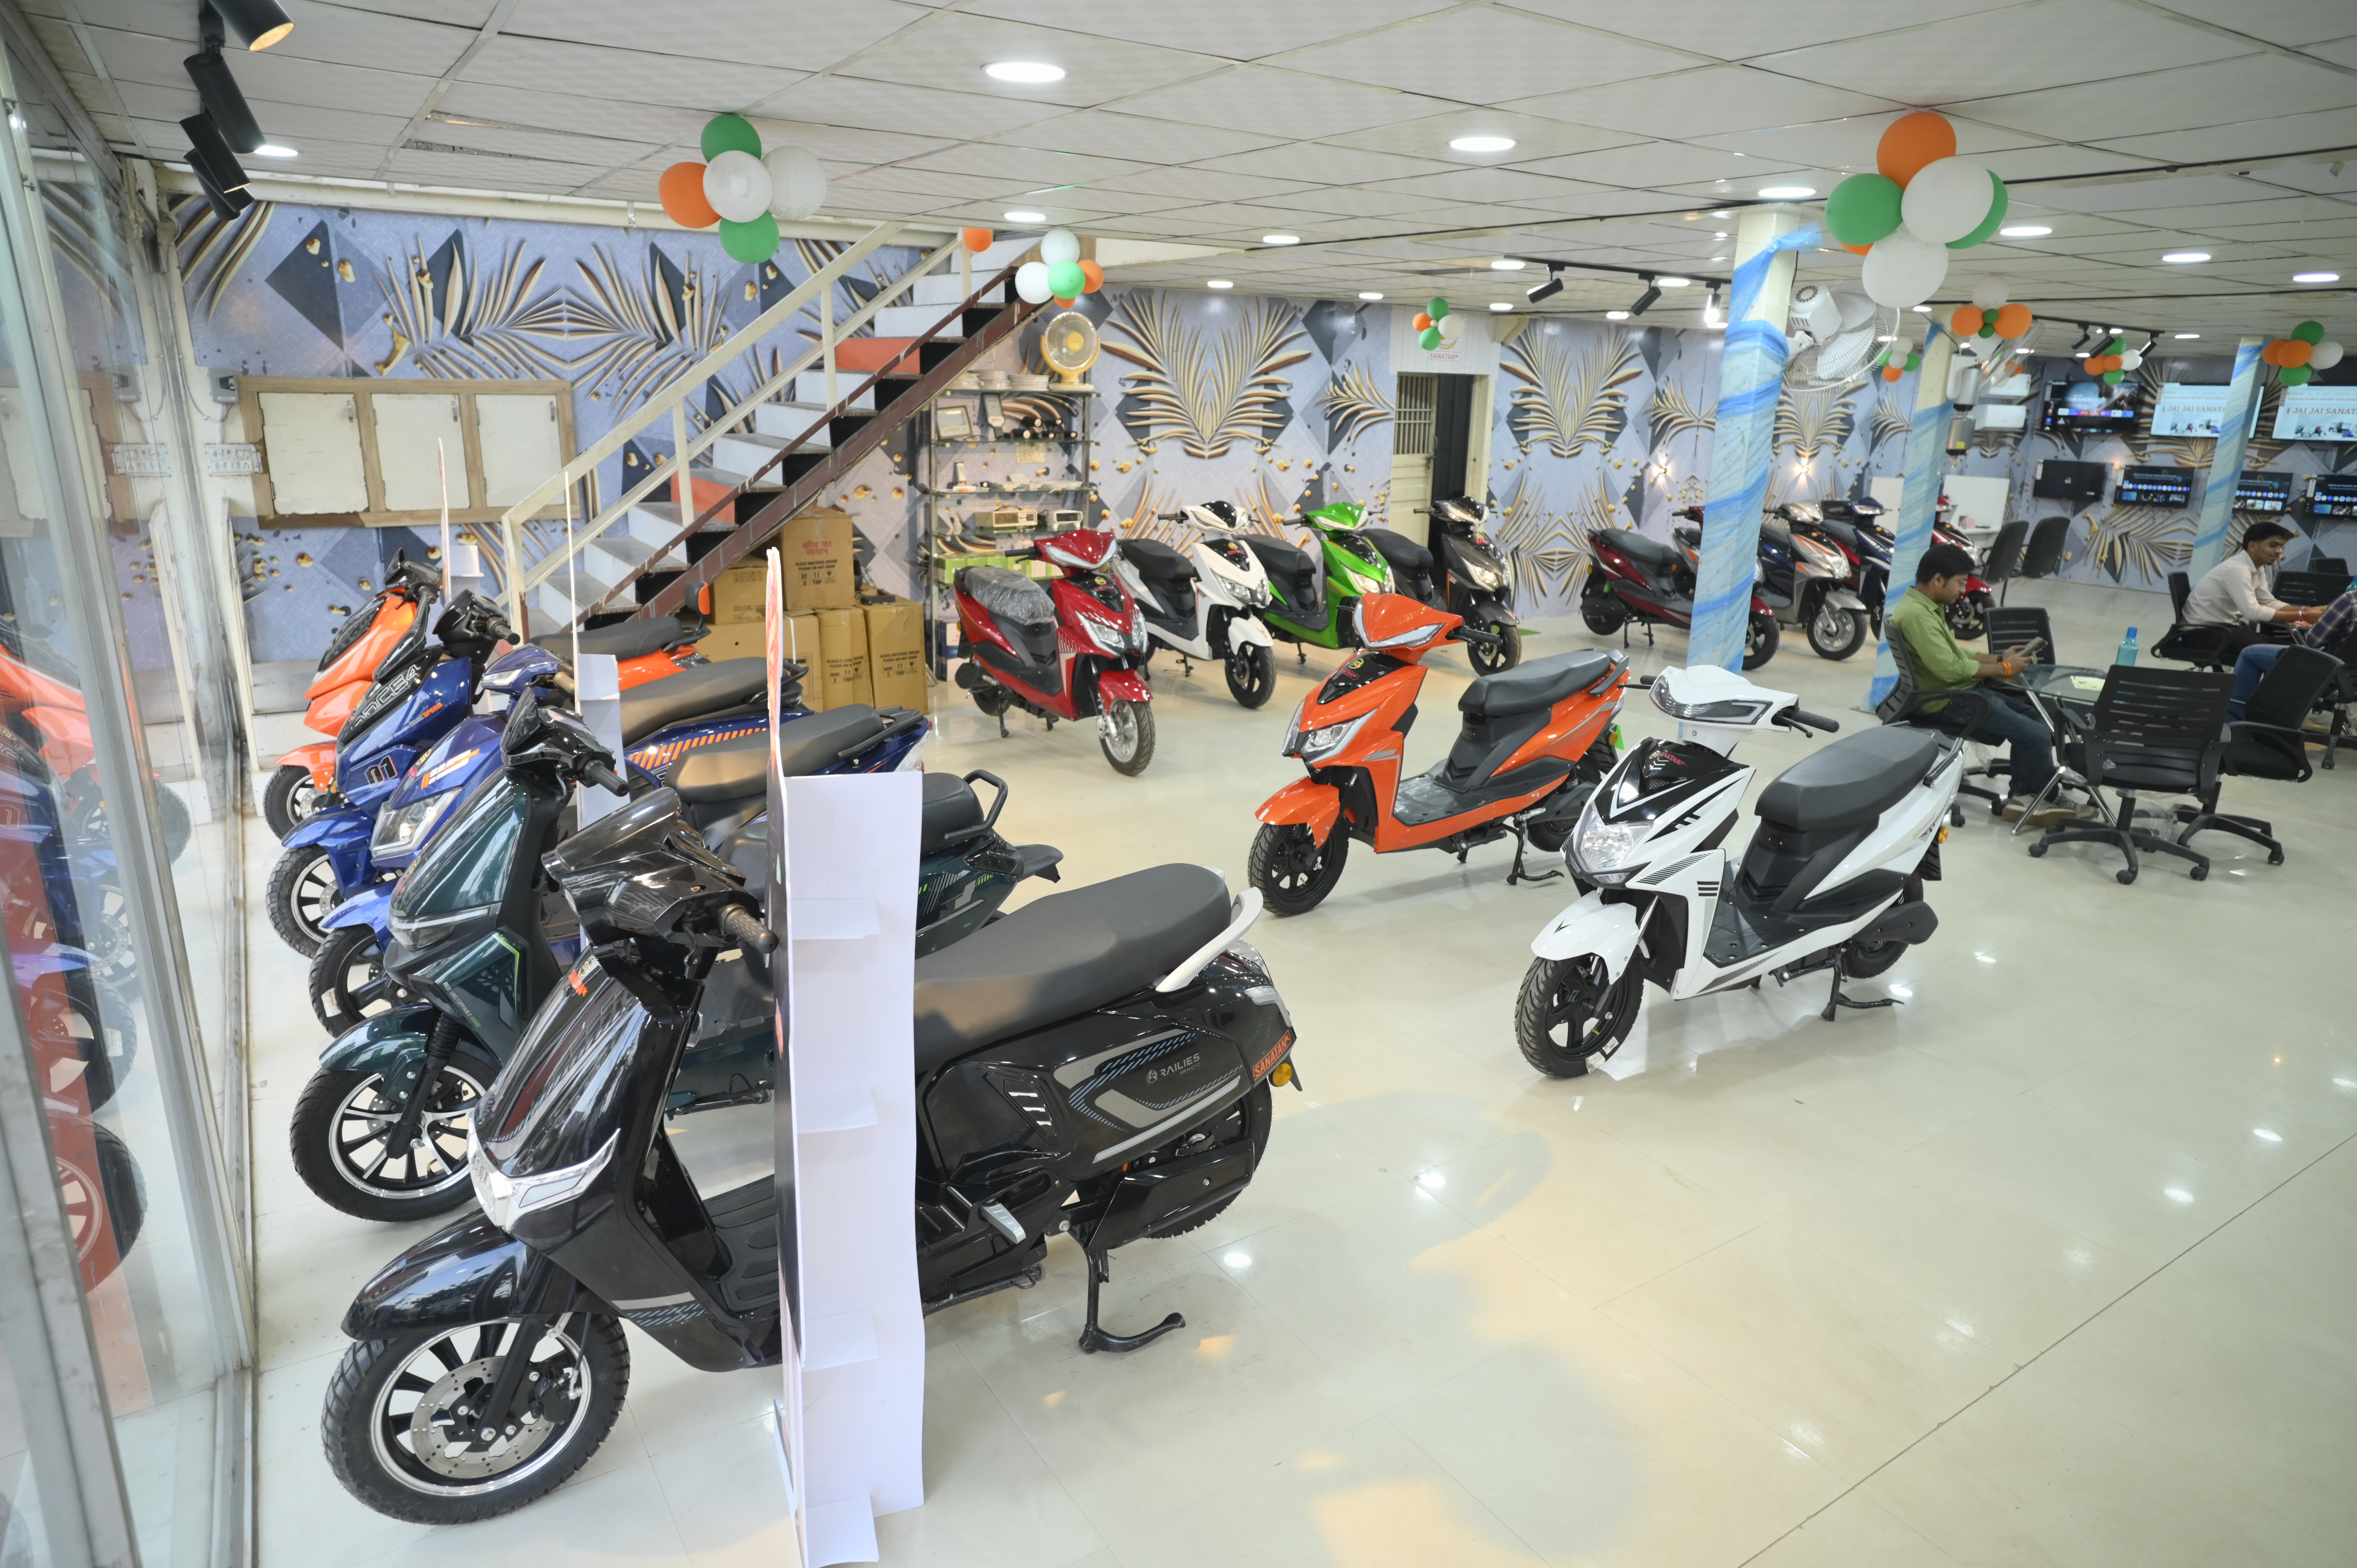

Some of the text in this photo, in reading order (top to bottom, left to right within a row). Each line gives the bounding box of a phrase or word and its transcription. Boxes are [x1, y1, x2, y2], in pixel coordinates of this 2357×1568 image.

[422, 702, 443, 718] SPEED
[443, 982, 473, 1017] RIDE UNSTOPPABLE
[1160, 1053, 1200, 1076] RAILIES
[1187, 1062, 1201, 1072] MOTO
[1255, 1036, 1287, 1077] SANATAN
